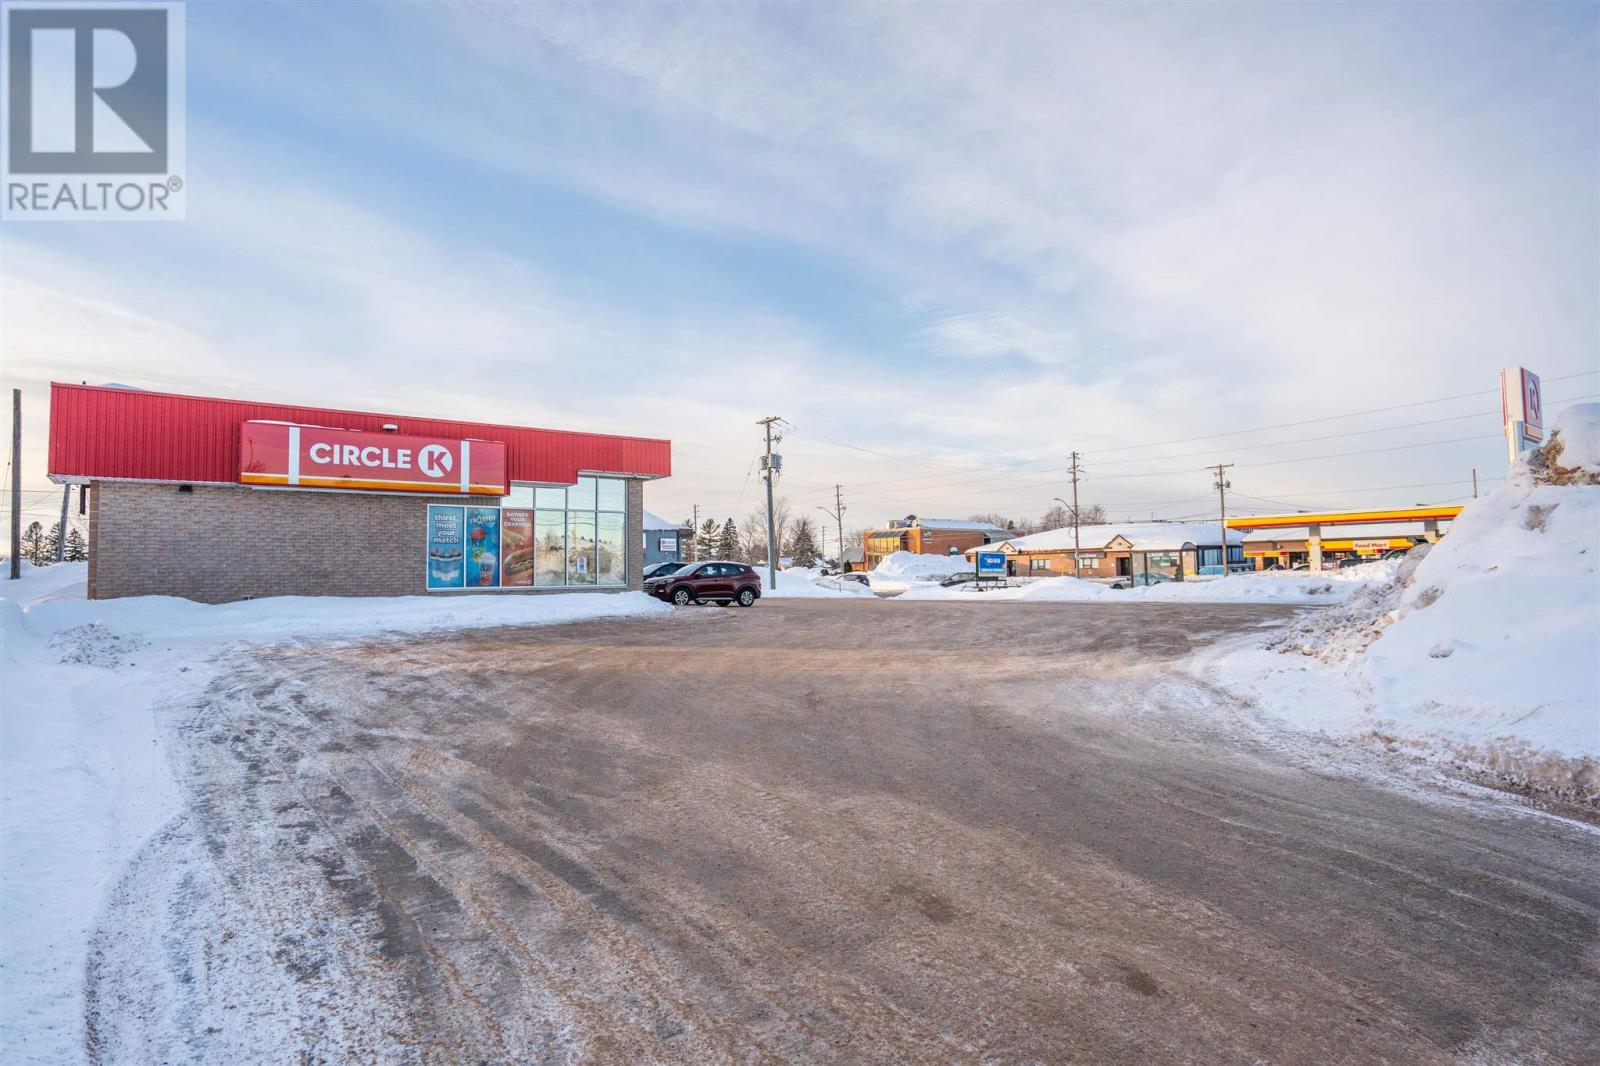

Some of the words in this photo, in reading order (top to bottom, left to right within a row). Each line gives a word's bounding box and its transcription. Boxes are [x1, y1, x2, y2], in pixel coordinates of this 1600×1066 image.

[309, 442, 411, 469] CIRCLE
[421, 445, 451, 476] K
[434, 536, 459, 544] match
